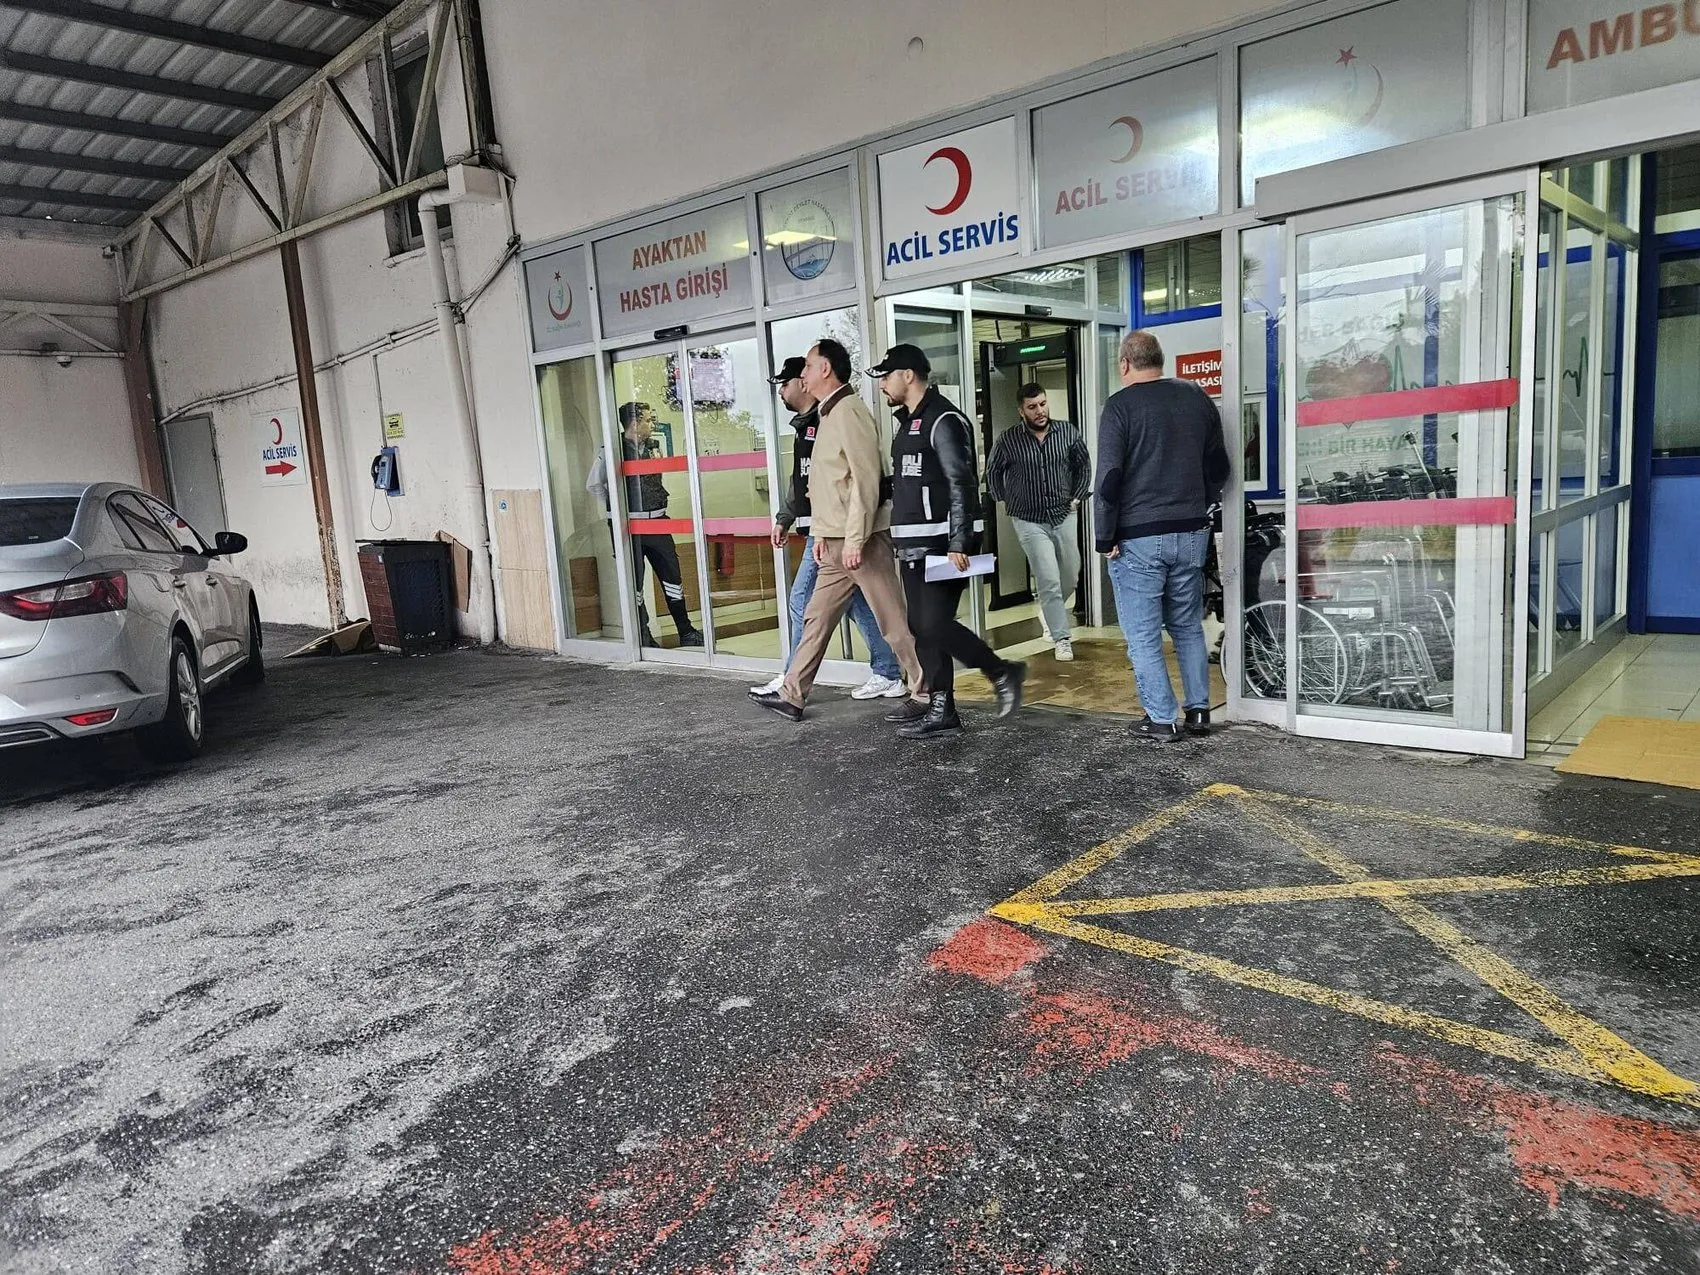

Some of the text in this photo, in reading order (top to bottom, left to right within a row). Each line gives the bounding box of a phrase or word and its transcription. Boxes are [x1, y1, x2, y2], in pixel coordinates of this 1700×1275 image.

[1055, 161, 1197, 215] ACİL SERV
[632, 230, 708, 271] AYAKTAN
[887, 211, 1019, 266] ACİL SERVİS
[620, 262, 729, 313] HASTA GİRİŞİ
[1182, 360, 1222, 374] İLETİŞİM
[1190, 376, 1222, 387] ASASI
[263, 443, 297, 461] ACİL SERVİS
